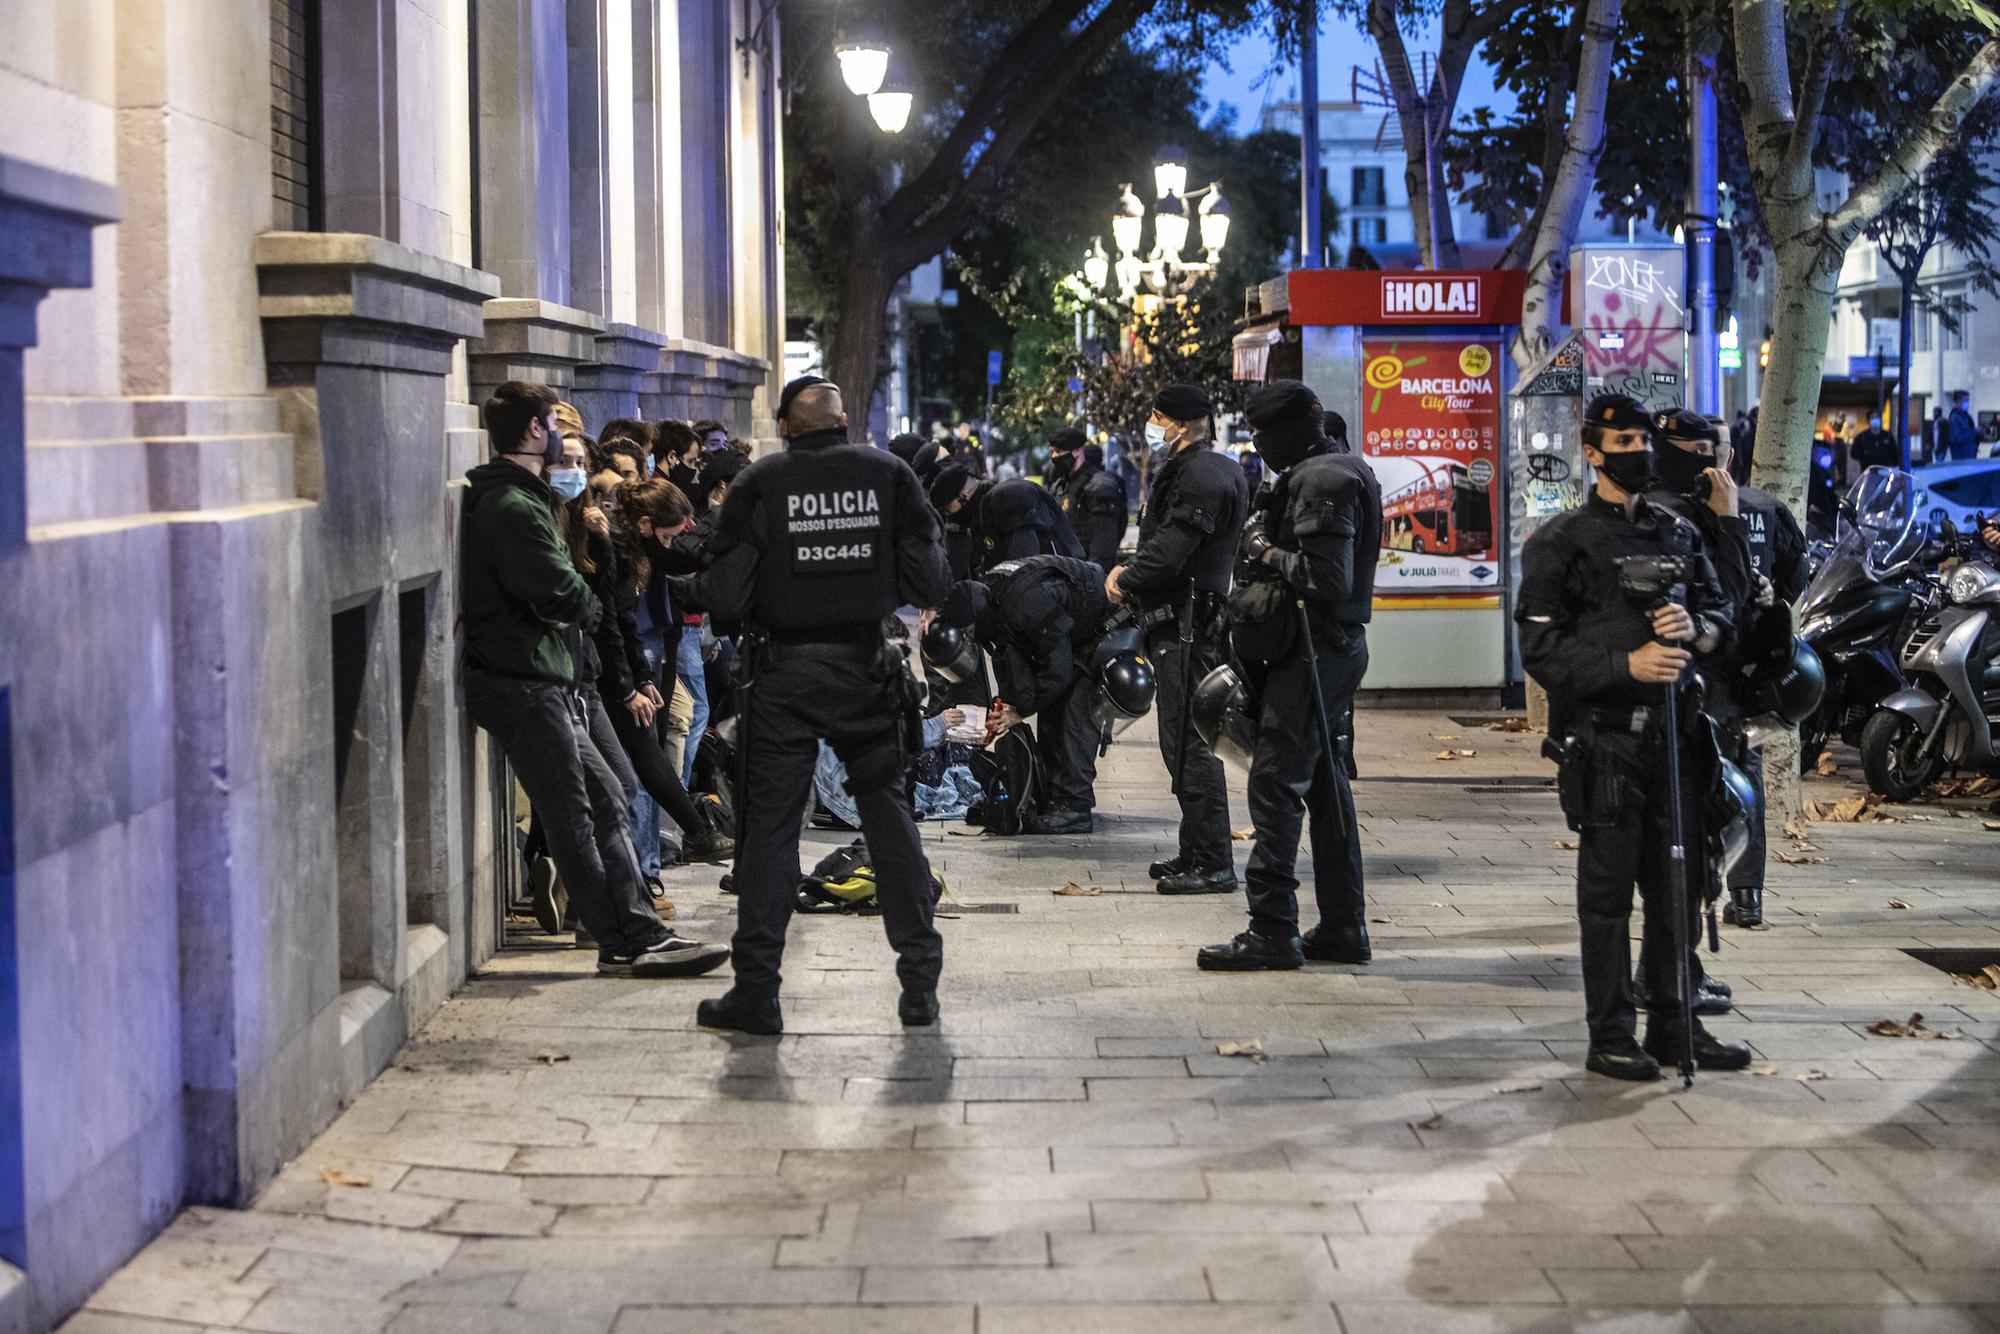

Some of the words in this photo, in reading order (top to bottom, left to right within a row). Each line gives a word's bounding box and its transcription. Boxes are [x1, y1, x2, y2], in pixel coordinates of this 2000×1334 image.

[1385, 281, 1476, 313] ¡HOLA!
[1400, 378, 1493, 394] BARCELONA
[787, 489, 880, 517] POLICIA
[788, 519, 826, 532] MOSSOS
[827, 515, 880, 530] D'ESQUADRA
[797, 543, 872, 561] D3C445
[1437, 567, 1460, 577] TRAVEL
